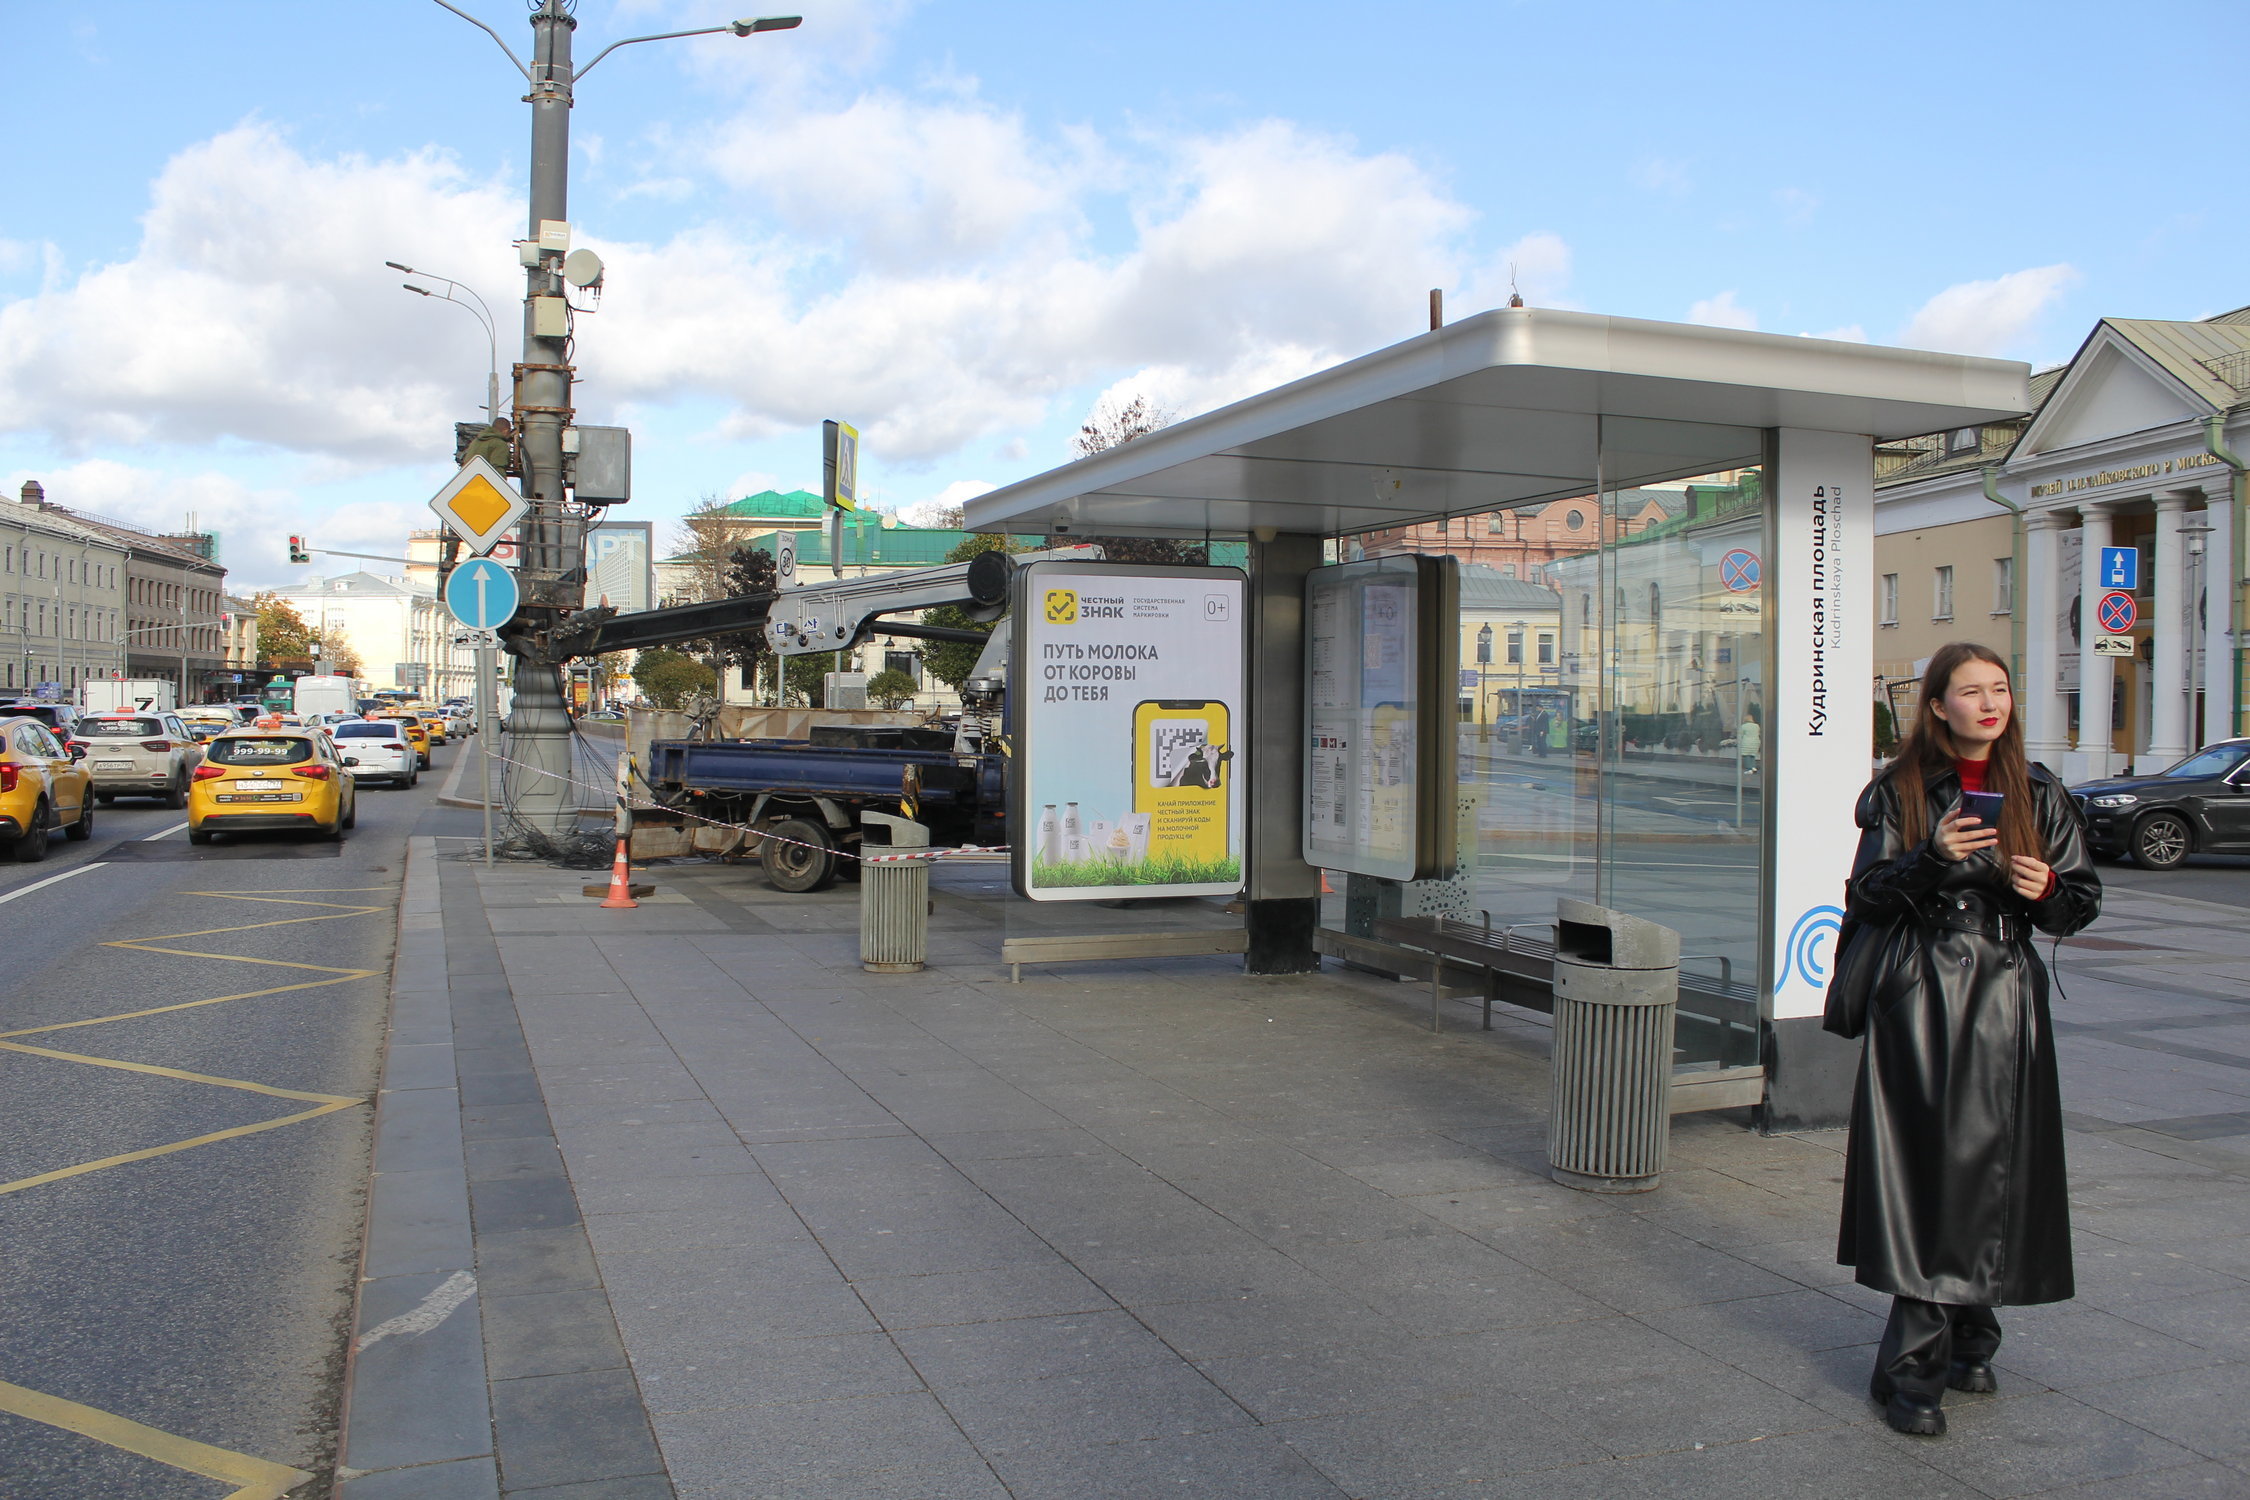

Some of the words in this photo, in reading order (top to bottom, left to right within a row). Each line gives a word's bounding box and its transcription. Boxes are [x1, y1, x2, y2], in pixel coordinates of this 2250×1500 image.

[2031, 479, 2062, 497] МУЗЕЙ
[2176, 452, 2222, 471] МОСКВ
[1830, 486, 1841, 552] Ploschad
[1813, 485, 1826, 591] площадь
[782, 556, 791, 568] 30
[1080, 596, 1124, 605] ЧЕСТНЫЙ
[1207, 600, 1226, 615] 0+
[1830, 557, 1843, 649] Kudrinskaya
[1081, 606, 1124, 618] ЗНАК
[1043, 644, 1084, 659] ПУТЬ
[1088, 644, 1159, 660] МОЛОКА
[1044, 665, 1066, 681] ОТ
[1069, 665, 1136, 681] КОРОВЫ
[1809, 597, 1827, 737] Кудринская
[1044, 685, 1068, 703] ДО
[1072, 686, 1109, 701] ТЕБЯ
[233, 747, 288, 756] 999-99-99
